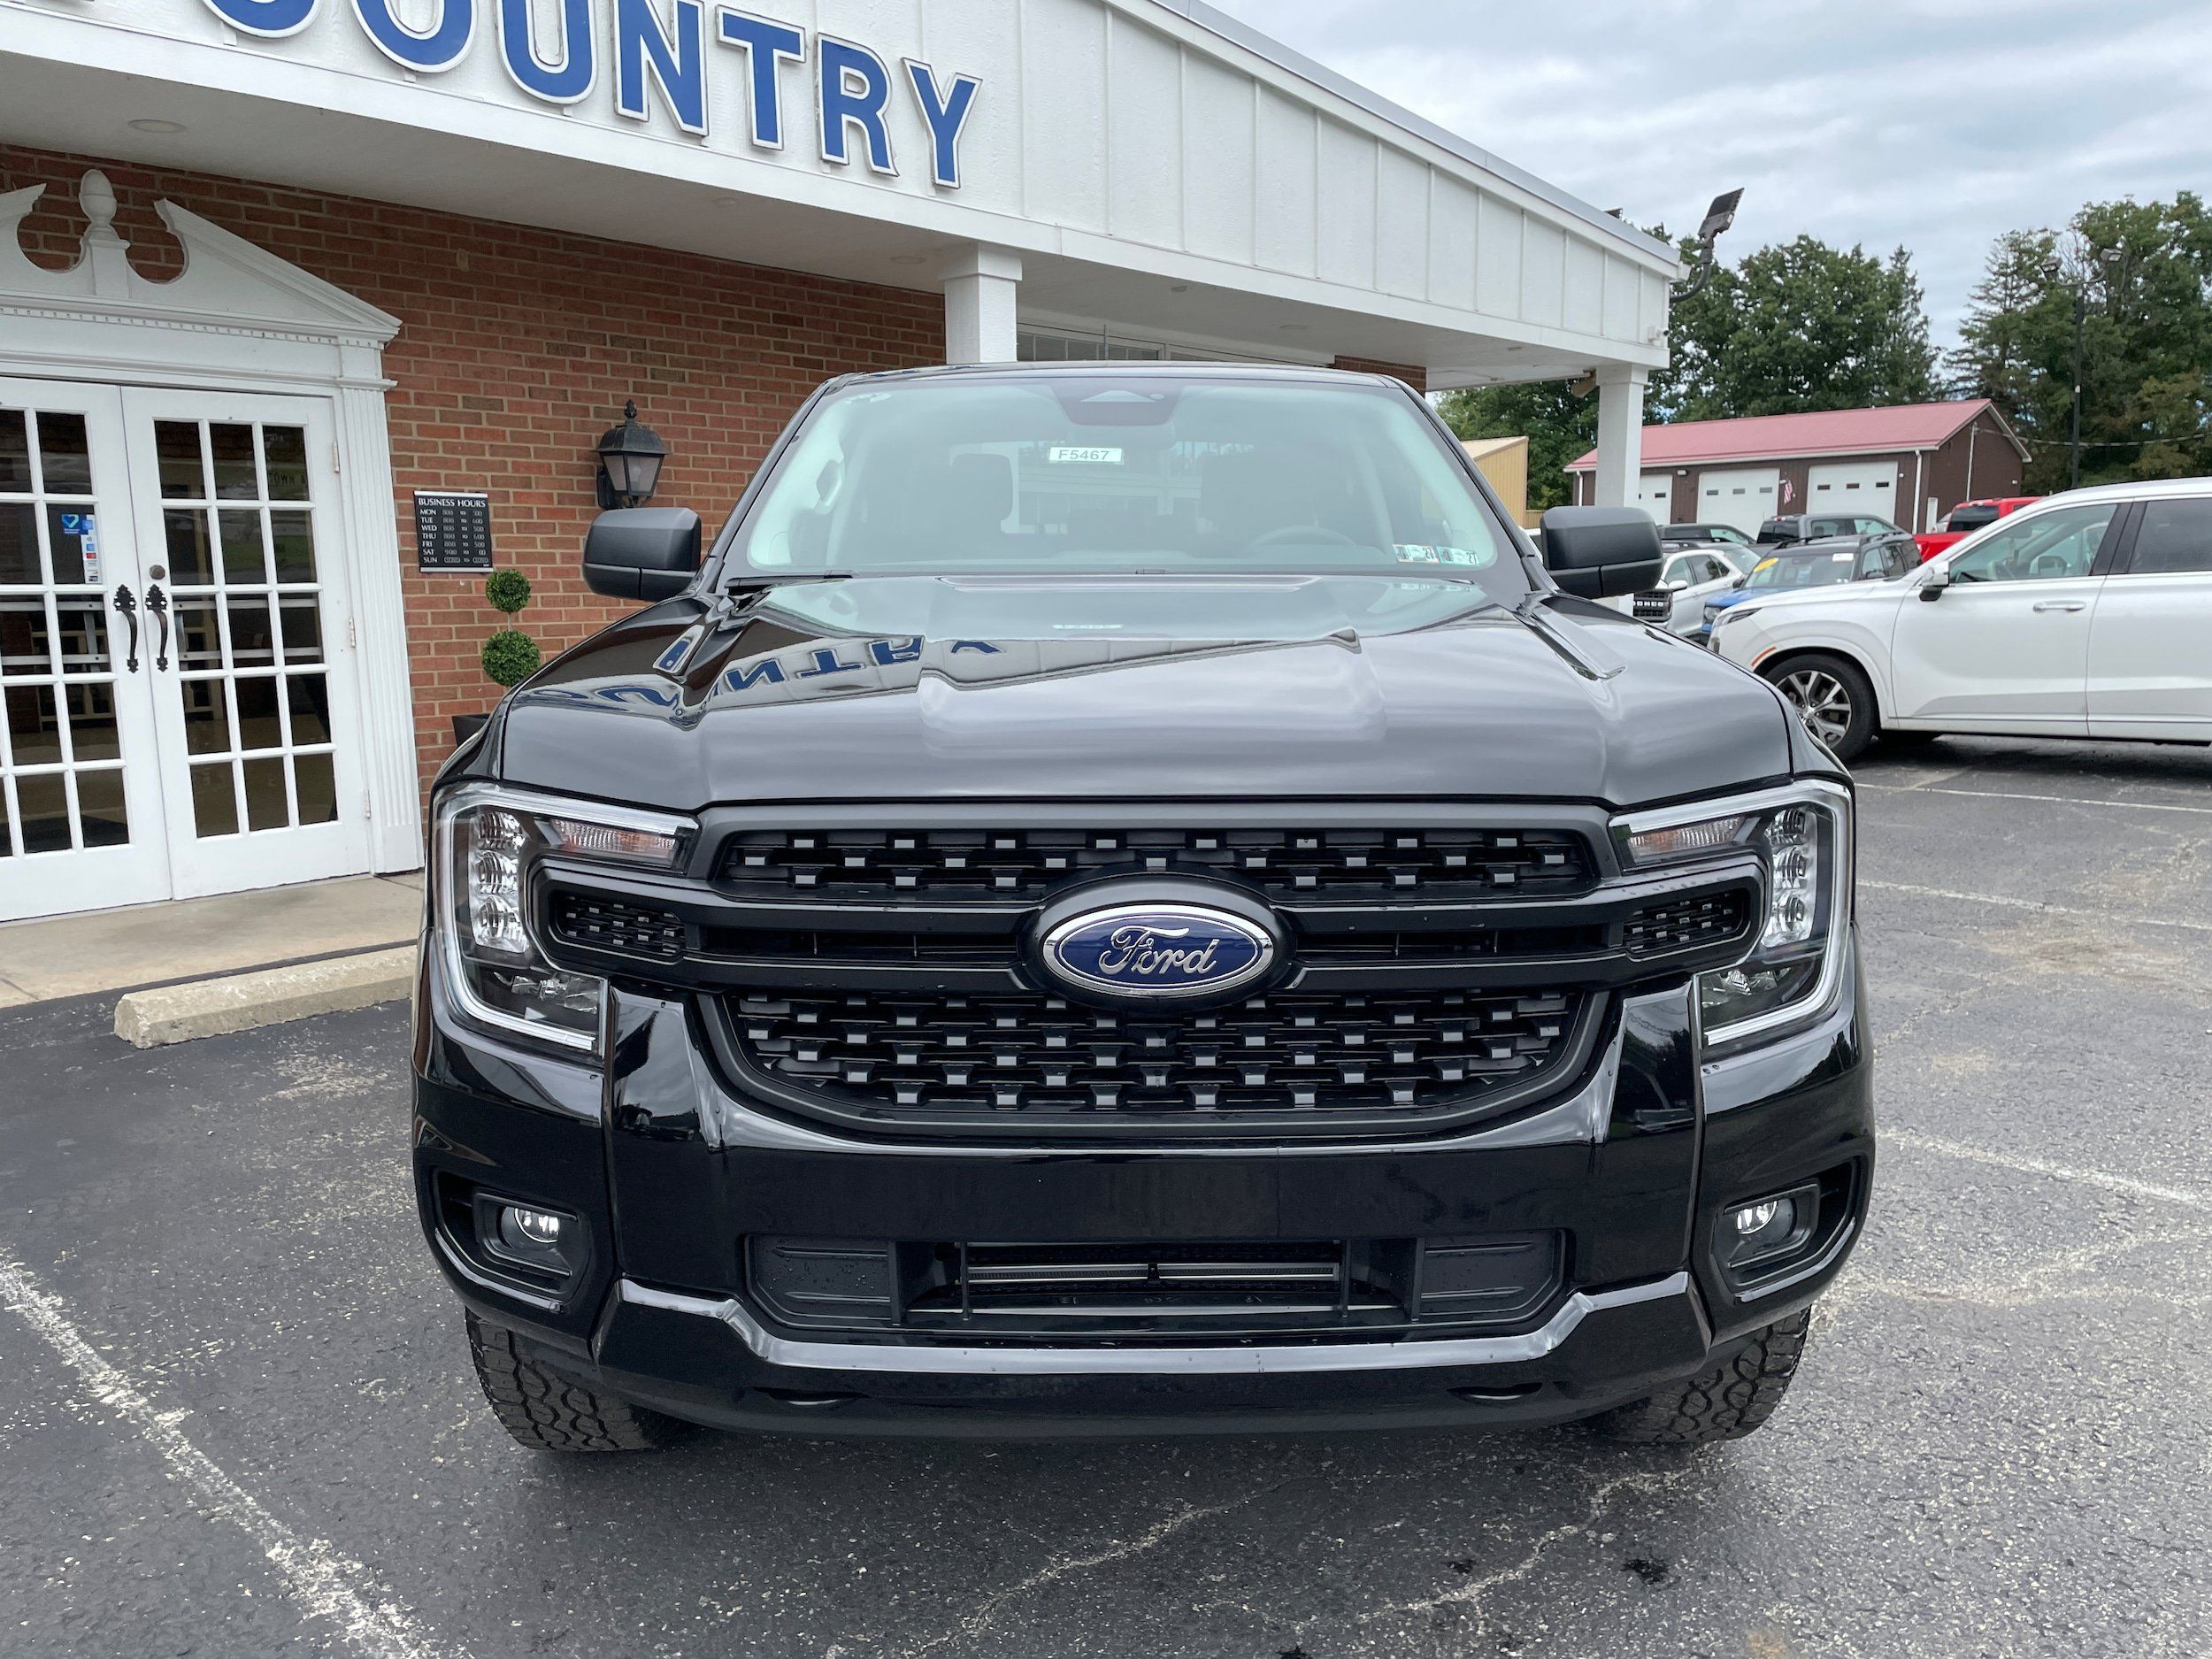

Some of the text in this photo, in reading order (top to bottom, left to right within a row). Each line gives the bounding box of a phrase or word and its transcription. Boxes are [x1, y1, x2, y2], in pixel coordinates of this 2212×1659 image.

[202, 0, 982, 188] OUNTRY
[1058, 449, 1110, 460] F5467
[418, 497, 486, 508] BUSINESS HOURS
[1098, 925, 1220, 974] Ford
